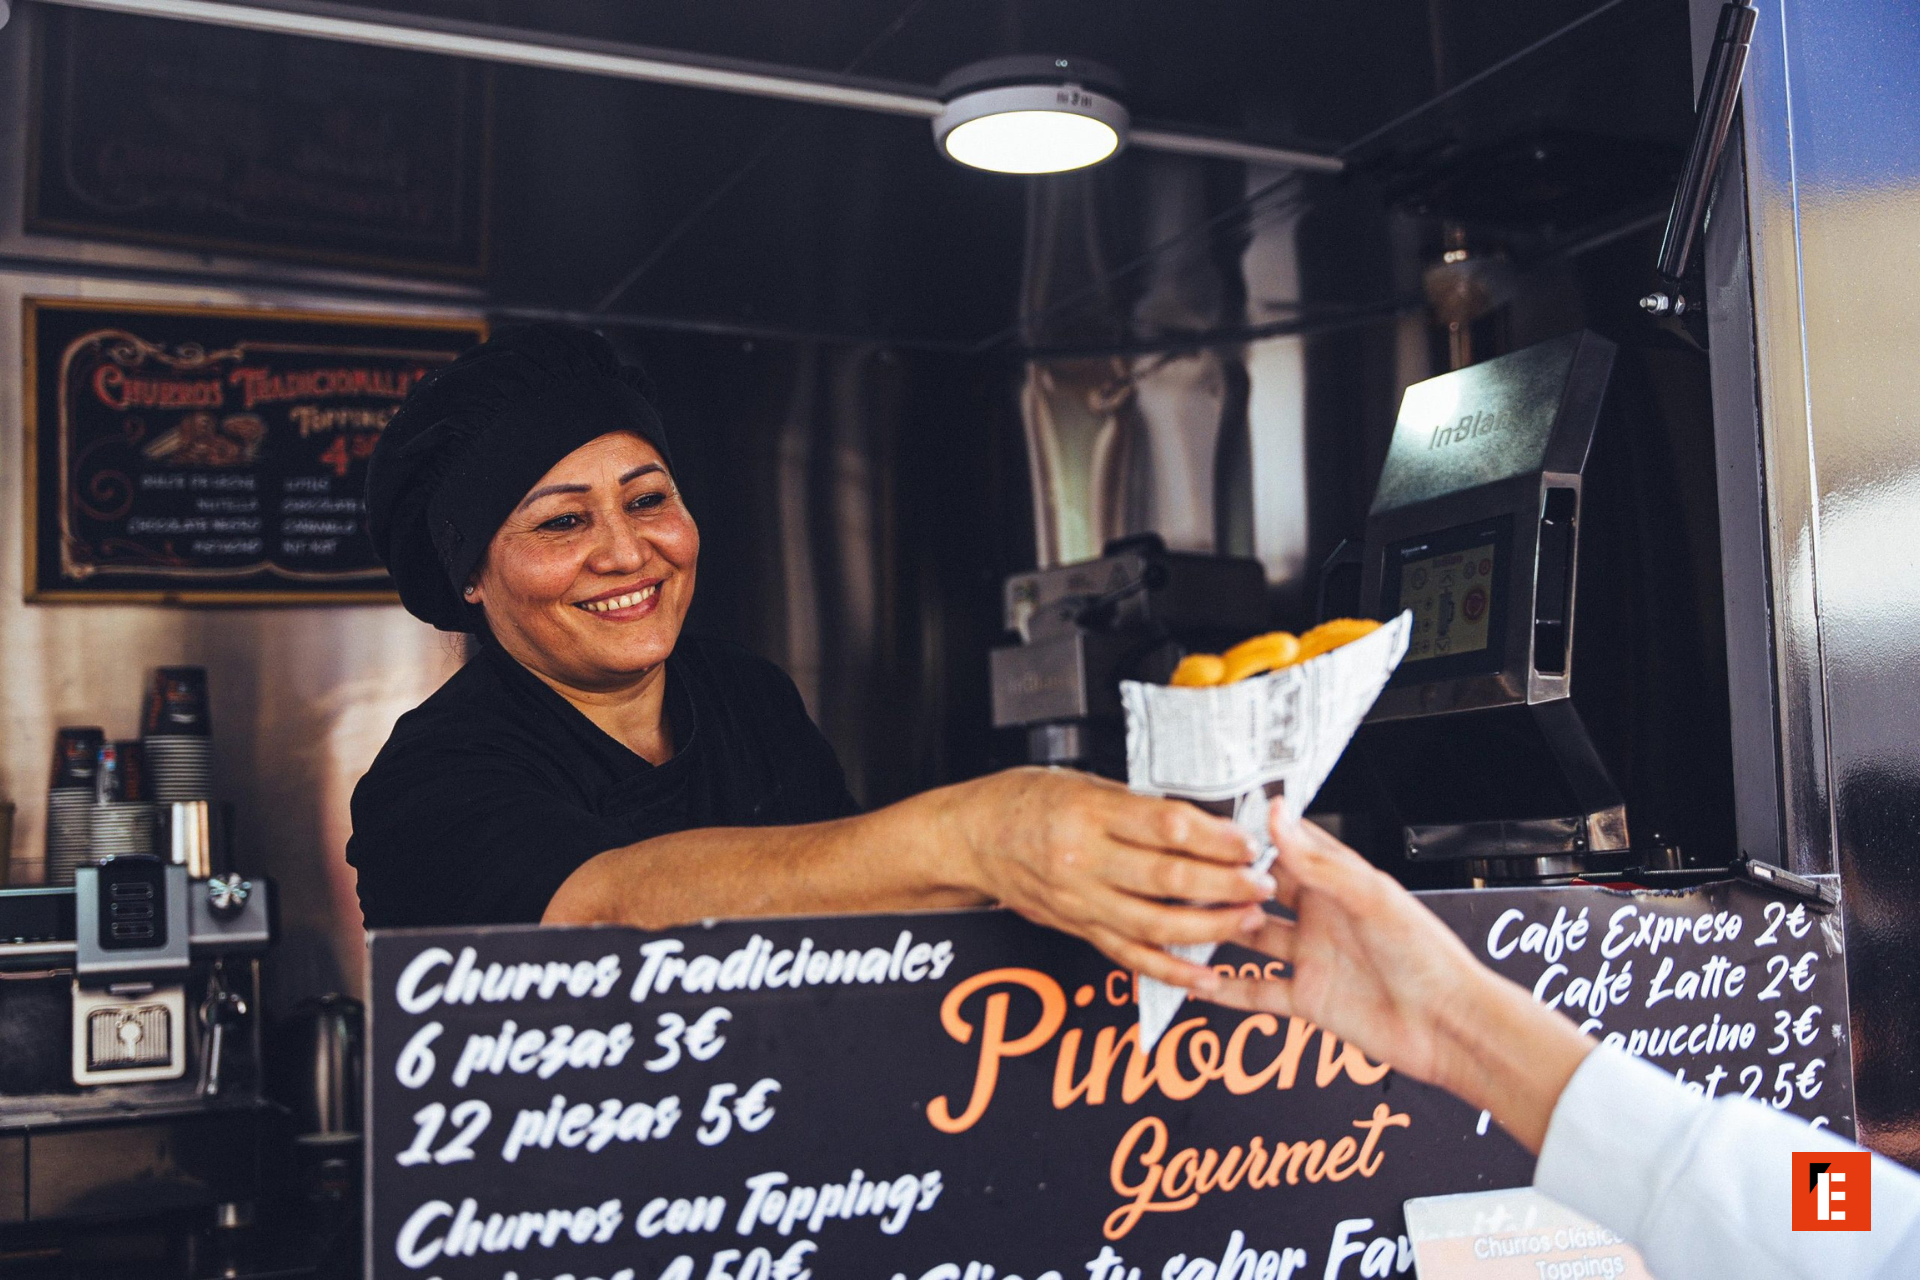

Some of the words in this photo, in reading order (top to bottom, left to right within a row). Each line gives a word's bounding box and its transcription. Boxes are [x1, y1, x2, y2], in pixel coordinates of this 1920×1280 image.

[1486, 907, 1590, 964] Café
[1600, 903, 1744, 961] Expreso
[1753, 900, 1813, 948] 2€
[395, 946, 623, 1014] Churros
[630, 930, 955, 1003] Tradicionales
[1531, 960, 1634, 1018] Café
[1644, 954, 1748, 1009] Latte
[1756, 950, 1819, 1002] 2€
[395, 1021, 445, 1090] 6
[452, 1019, 635, 1089] piezas
[644, 1006, 733, 1073] 3€
[1766, 1004, 1824, 1057] 3€
[396, 1099, 492, 1167] 12
[502, 1094, 682, 1163] piezas
[696, 1077, 783, 1146] 5€
[1102, 1102, 1412, 1241] Gourmet
[395, 1197, 624, 1269] Churros
[635, 1195, 727, 1238] con
[736, 1168, 944, 1236] Toppings
[1474, 1235, 1550, 1260] Churros
[1535, 1254, 1624, 1280] Toppings
